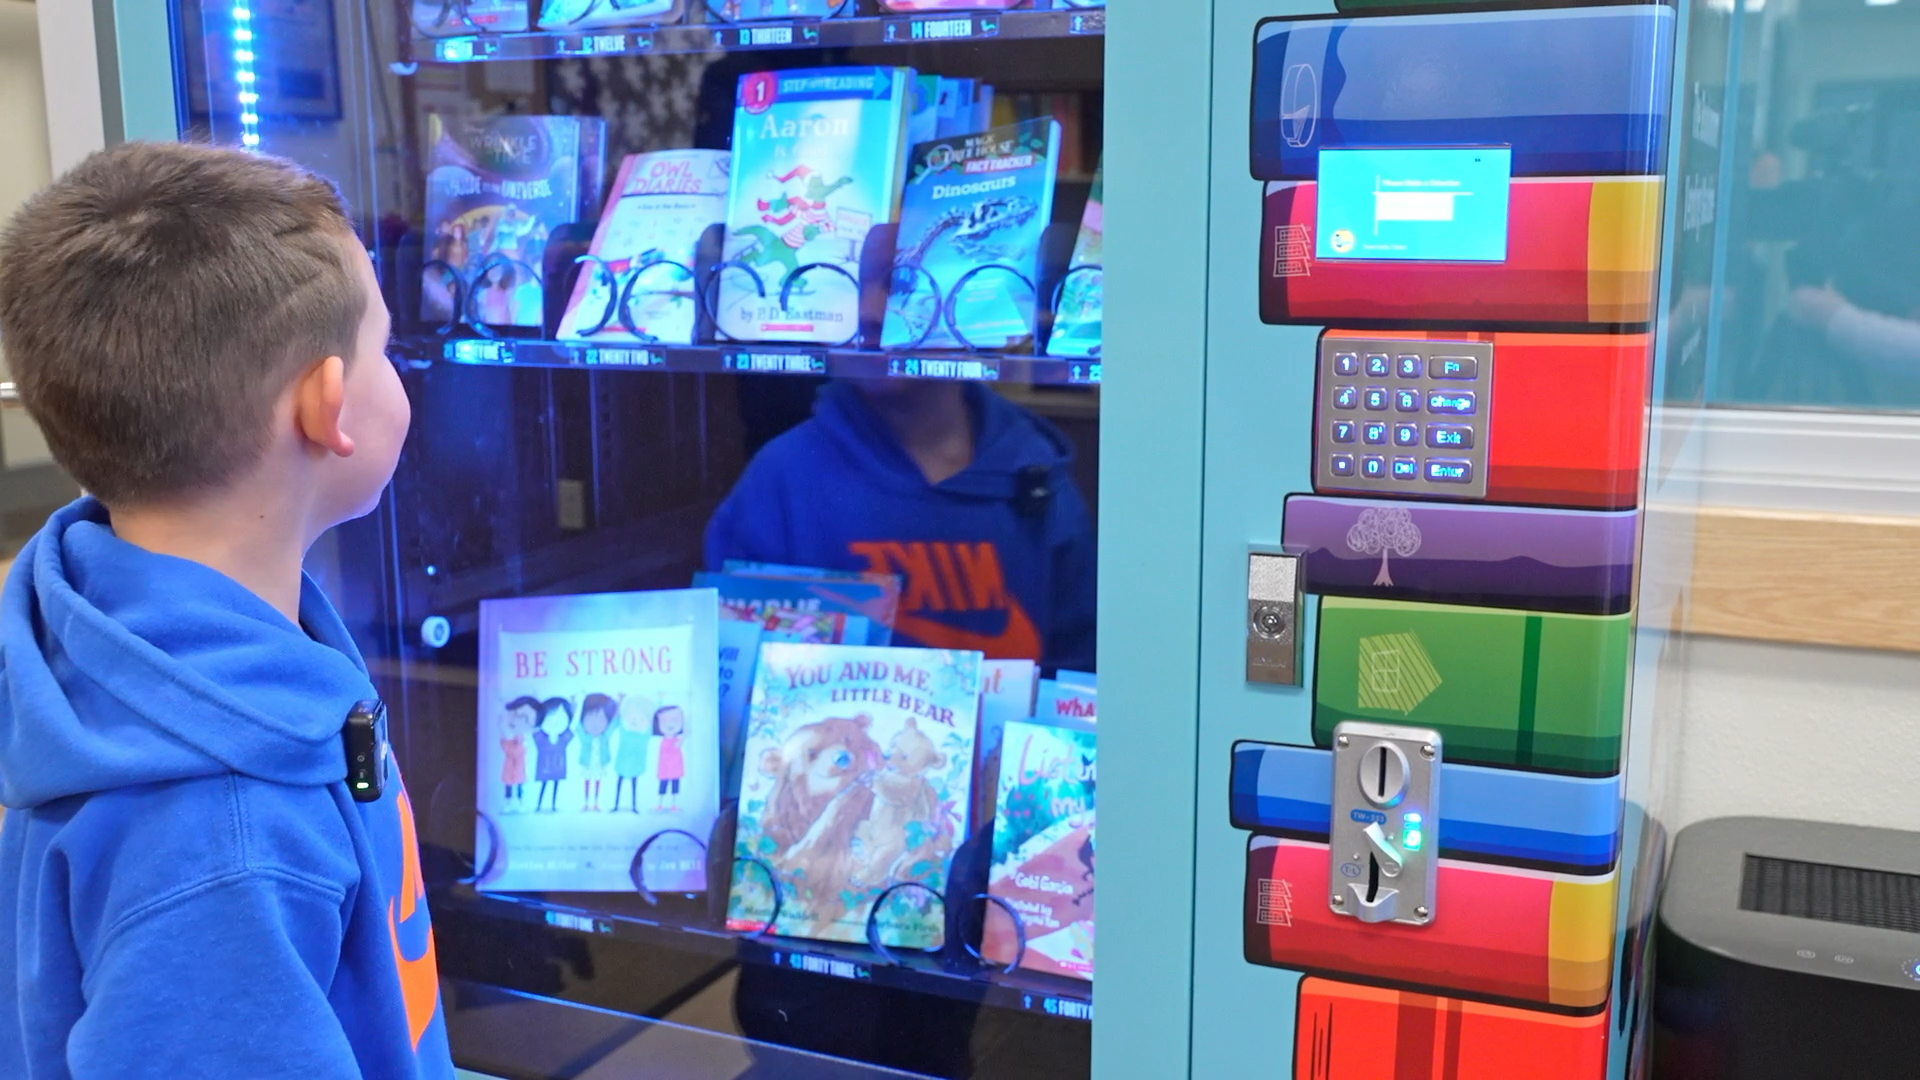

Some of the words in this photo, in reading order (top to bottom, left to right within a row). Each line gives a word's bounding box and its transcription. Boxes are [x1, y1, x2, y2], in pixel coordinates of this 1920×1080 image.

[739, 28, 750, 45] 13
[751, 27, 793, 45] THIRTEEN
[911, 21, 923, 39] 14
[924, 19, 972, 38] FOURTEEN
[593, 34, 626, 53] TWELVE
[756, 81, 766, 102] 1
[783, 79, 807, 92] STEP
[823, 75, 874, 90] READING
[760, 113, 849, 139] Aaron
[650, 160, 693, 178] OWL
[965, 159, 988, 173] FACT
[990, 154, 1034, 171] TRACKER
[632, 177, 703, 194] DIARIES
[932, 175, 1017, 200] Dinosaurs
[740, 306, 754, 324] by
[784, 307, 844, 323] Eastman
[585, 348, 598, 365] 22
[598, 347, 630, 366] TWENTY
[630, 348, 649, 366] TWO
[736, 353, 749, 370] 23
[750, 353, 784, 371] TWENTY
[784, 354, 812, 372] THREE
[1342, 357, 1350, 371] 1
[1371, 358, 1382, 371] 2
[1403, 359, 1414, 373] 3
[1444, 361, 1460, 374] Fn
[905, 359, 919, 375] 24
[920, 359, 957, 377] TWENTY
[956, 361, 982, 378] FOUR
[1339, 391, 1349, 405] 4
[1370, 393, 1380, 406] 5
[1402, 394, 1412, 408] 6
[1338, 425, 1348, 439] 7
[1368, 427, 1379, 440] 8
[1400, 428, 1411, 442] 9
[1436, 430, 1462, 445] Exit
[1368, 460, 1378, 473] 0
[1395, 462, 1414, 475] Del
[1430, 464, 1465, 478] Enter
[514, 650, 548, 679] BE
[566, 645, 672, 677] STRONG
[784, 663, 832, 690] YOU
[838, 659, 889, 683] AND
[893, 663, 935, 696] ME,
[830, 687, 893, 704] LITTLE
[898, 692, 957, 728] BEAR
[802, 954, 829, 974] FORTY
[829, 959, 856, 979] THREE
[1043, 996, 1058, 1015] 45
[1058, 999, 1088, 1020] FORTY
